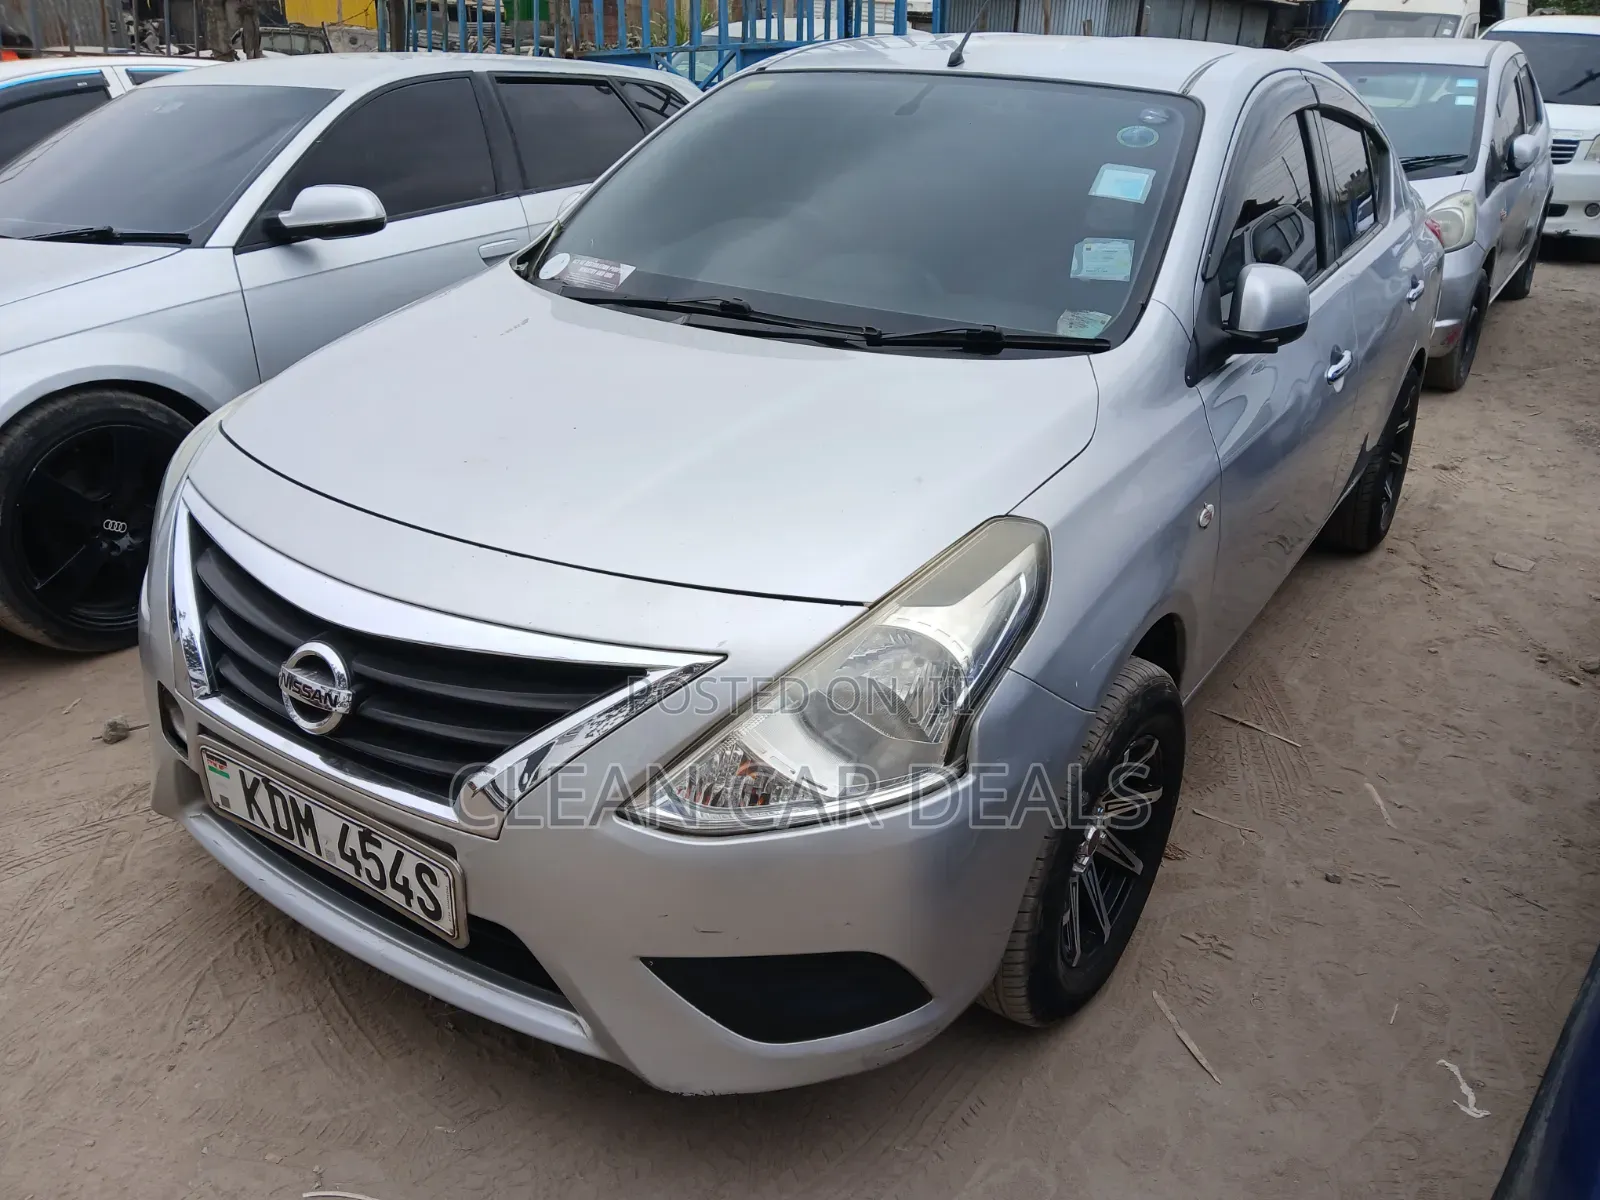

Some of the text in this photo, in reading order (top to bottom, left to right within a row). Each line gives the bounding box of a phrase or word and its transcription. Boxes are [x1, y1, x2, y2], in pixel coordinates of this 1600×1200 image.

[280, 671, 339, 708] NISSAN
[238, 769, 443, 922] KDM 454S
